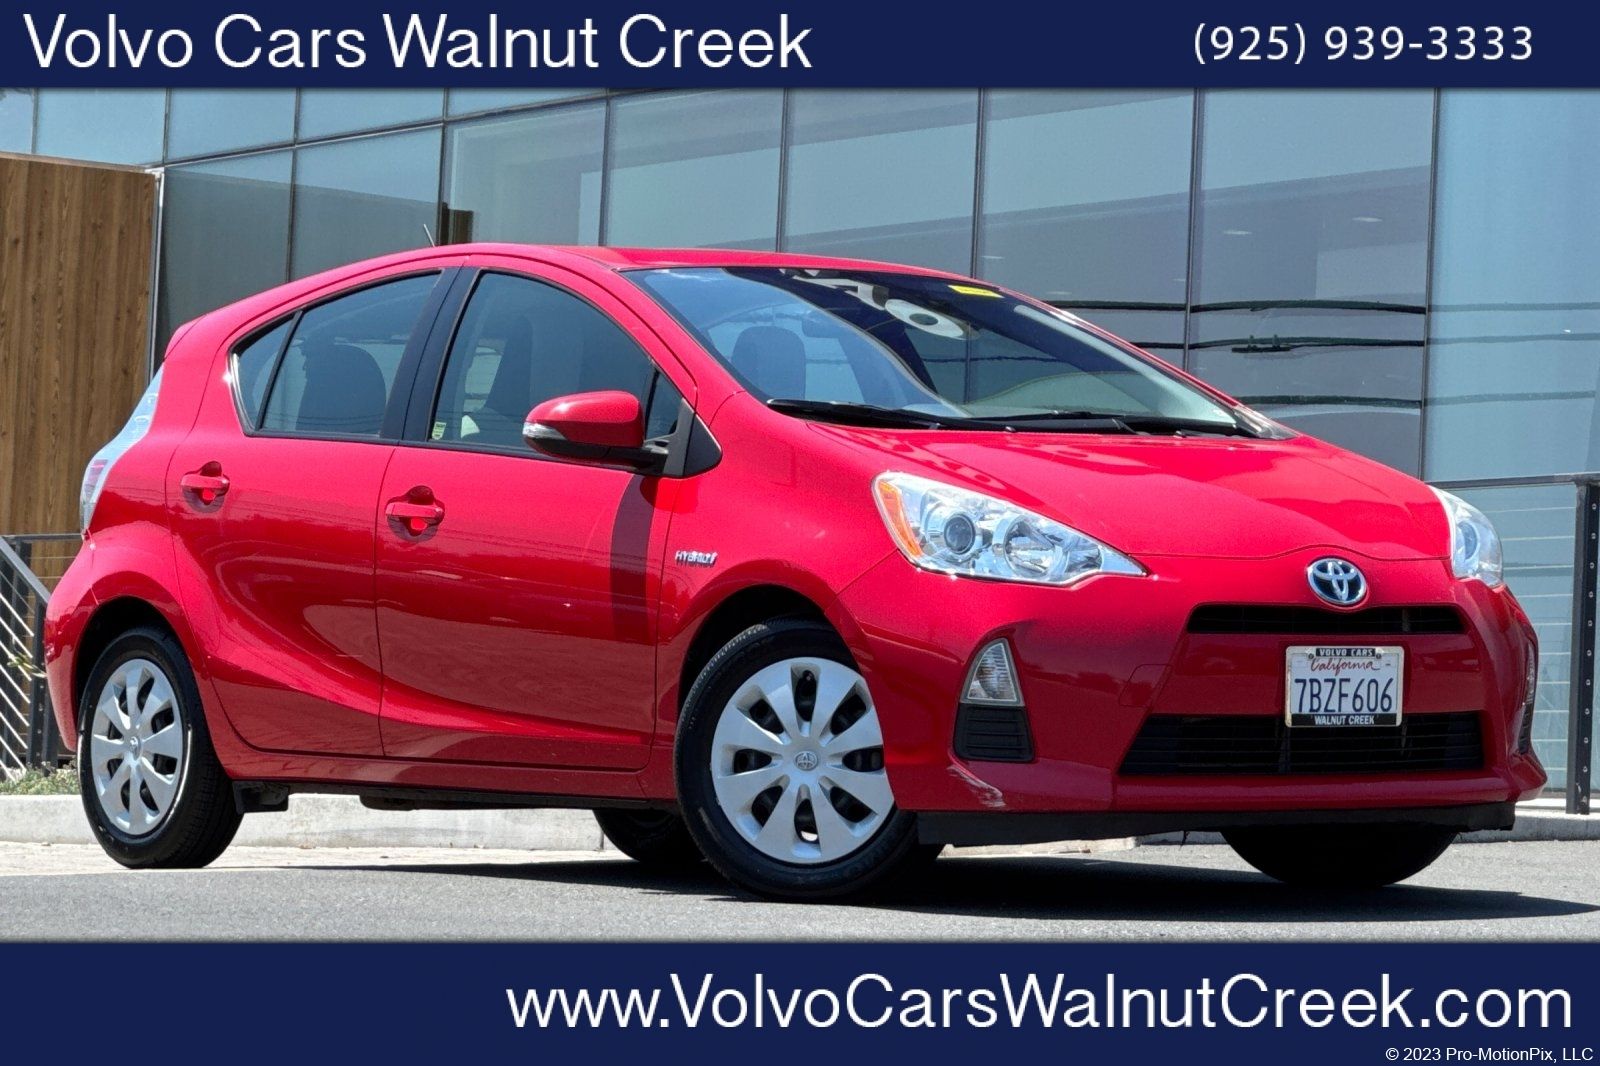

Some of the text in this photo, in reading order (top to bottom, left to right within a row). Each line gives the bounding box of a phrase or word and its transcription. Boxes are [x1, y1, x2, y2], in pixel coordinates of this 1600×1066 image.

[1319, 648, 1373, 657] VOLVO CARS
[1310, 658, 1380, 676] California
[1294, 677, 1394, 713] 7BZF606
[1314, 715, 1375, 725] WALNUT CREEK
